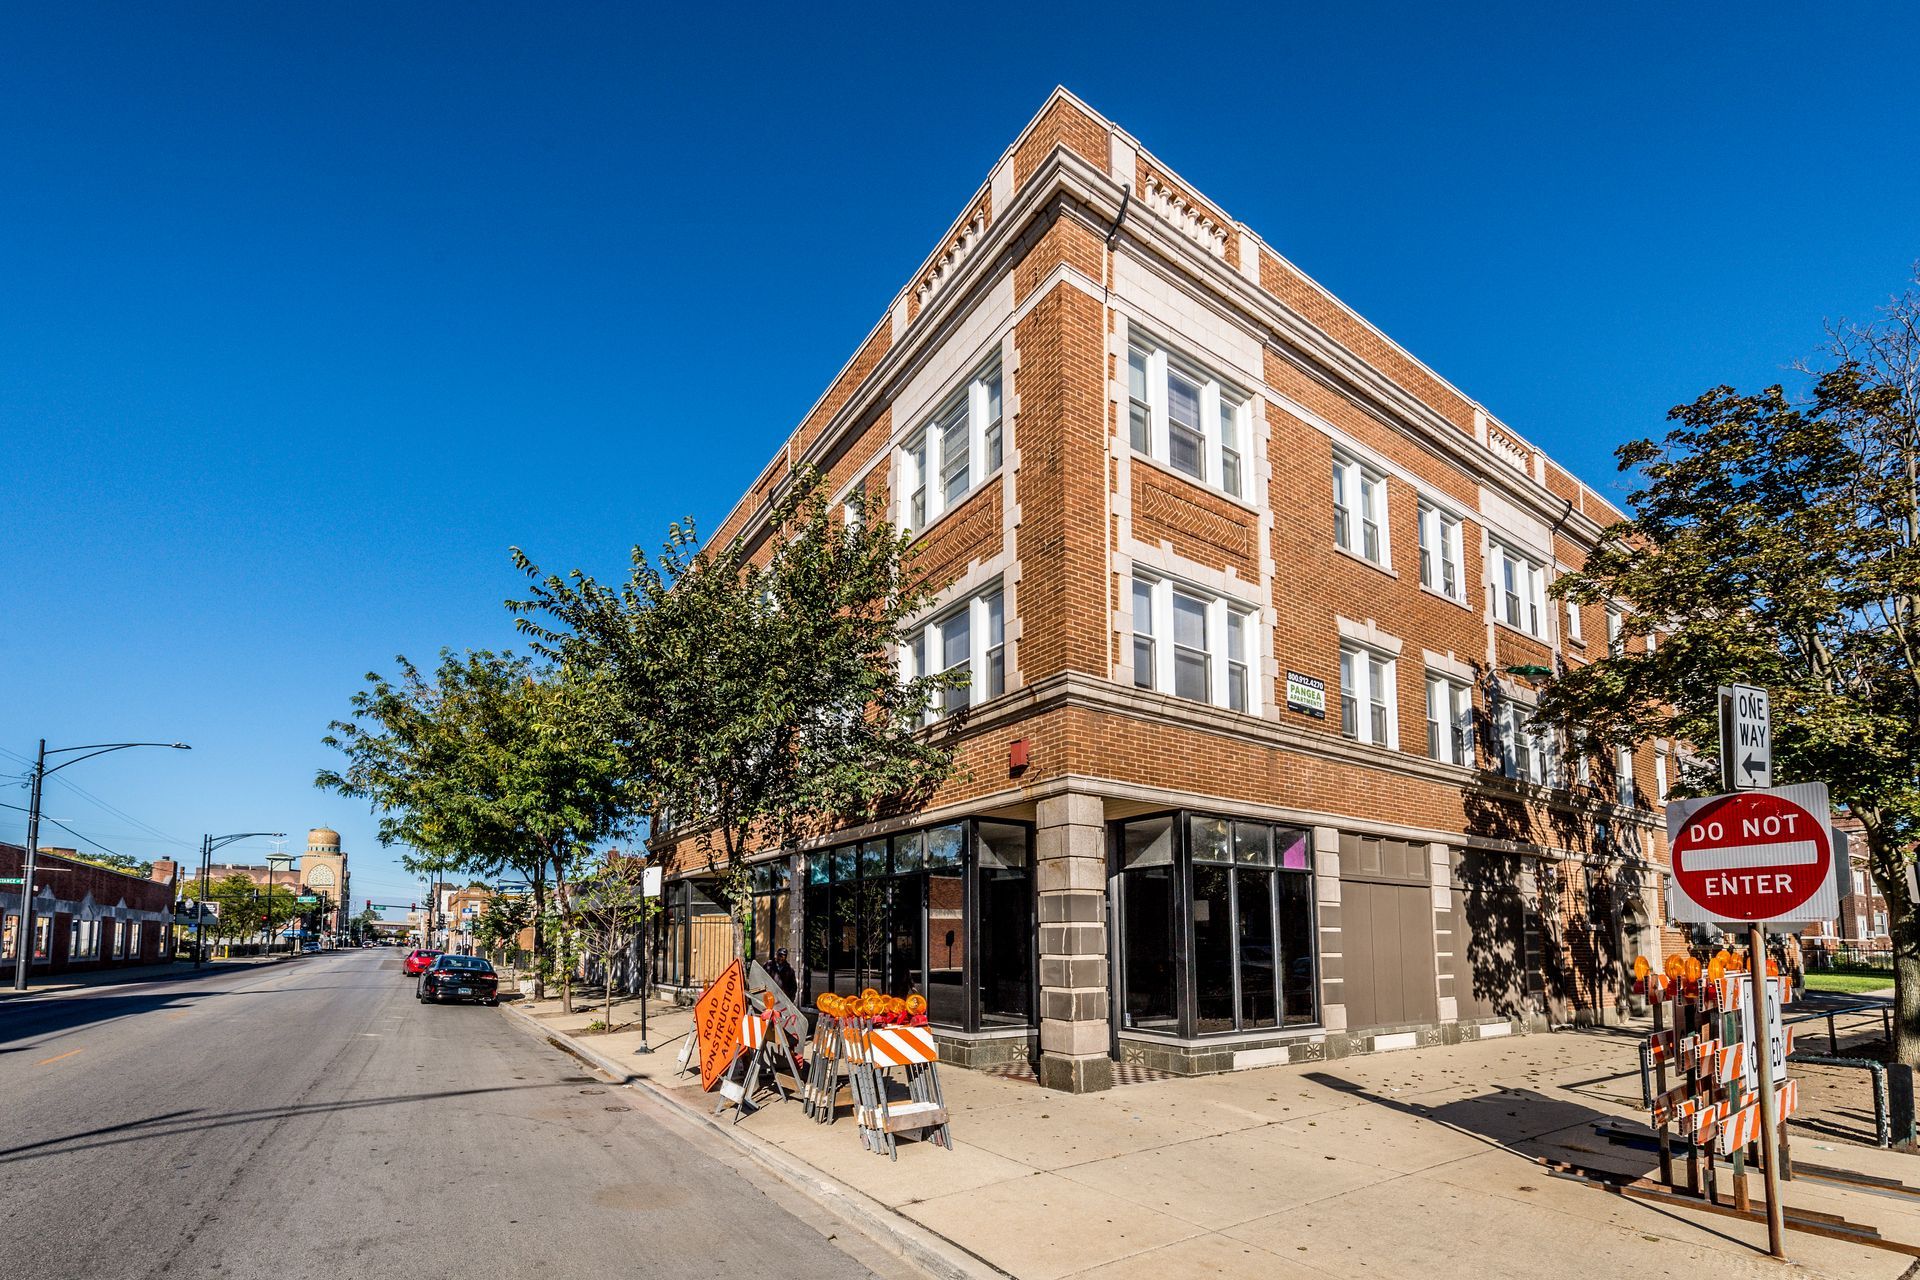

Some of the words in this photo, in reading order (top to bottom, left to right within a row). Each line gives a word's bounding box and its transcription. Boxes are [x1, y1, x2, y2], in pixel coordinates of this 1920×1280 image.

[1290, 684, 1321, 701] PANGEA
[1290, 694, 1322, 708] APARTMENTS
[1739, 694, 1765, 721] ONE
[1739, 723, 1766, 748] WAY
[1690, 822, 1724, 843] DO
[1742, 813, 1799, 838] NOT
[1705, 873, 1793, 897] ENTER
[703, 997, 719, 1041] ROAD
[704, 970, 738, 1081] CONSTRUCTION
[721, 1003, 741, 1059] AHEAD
